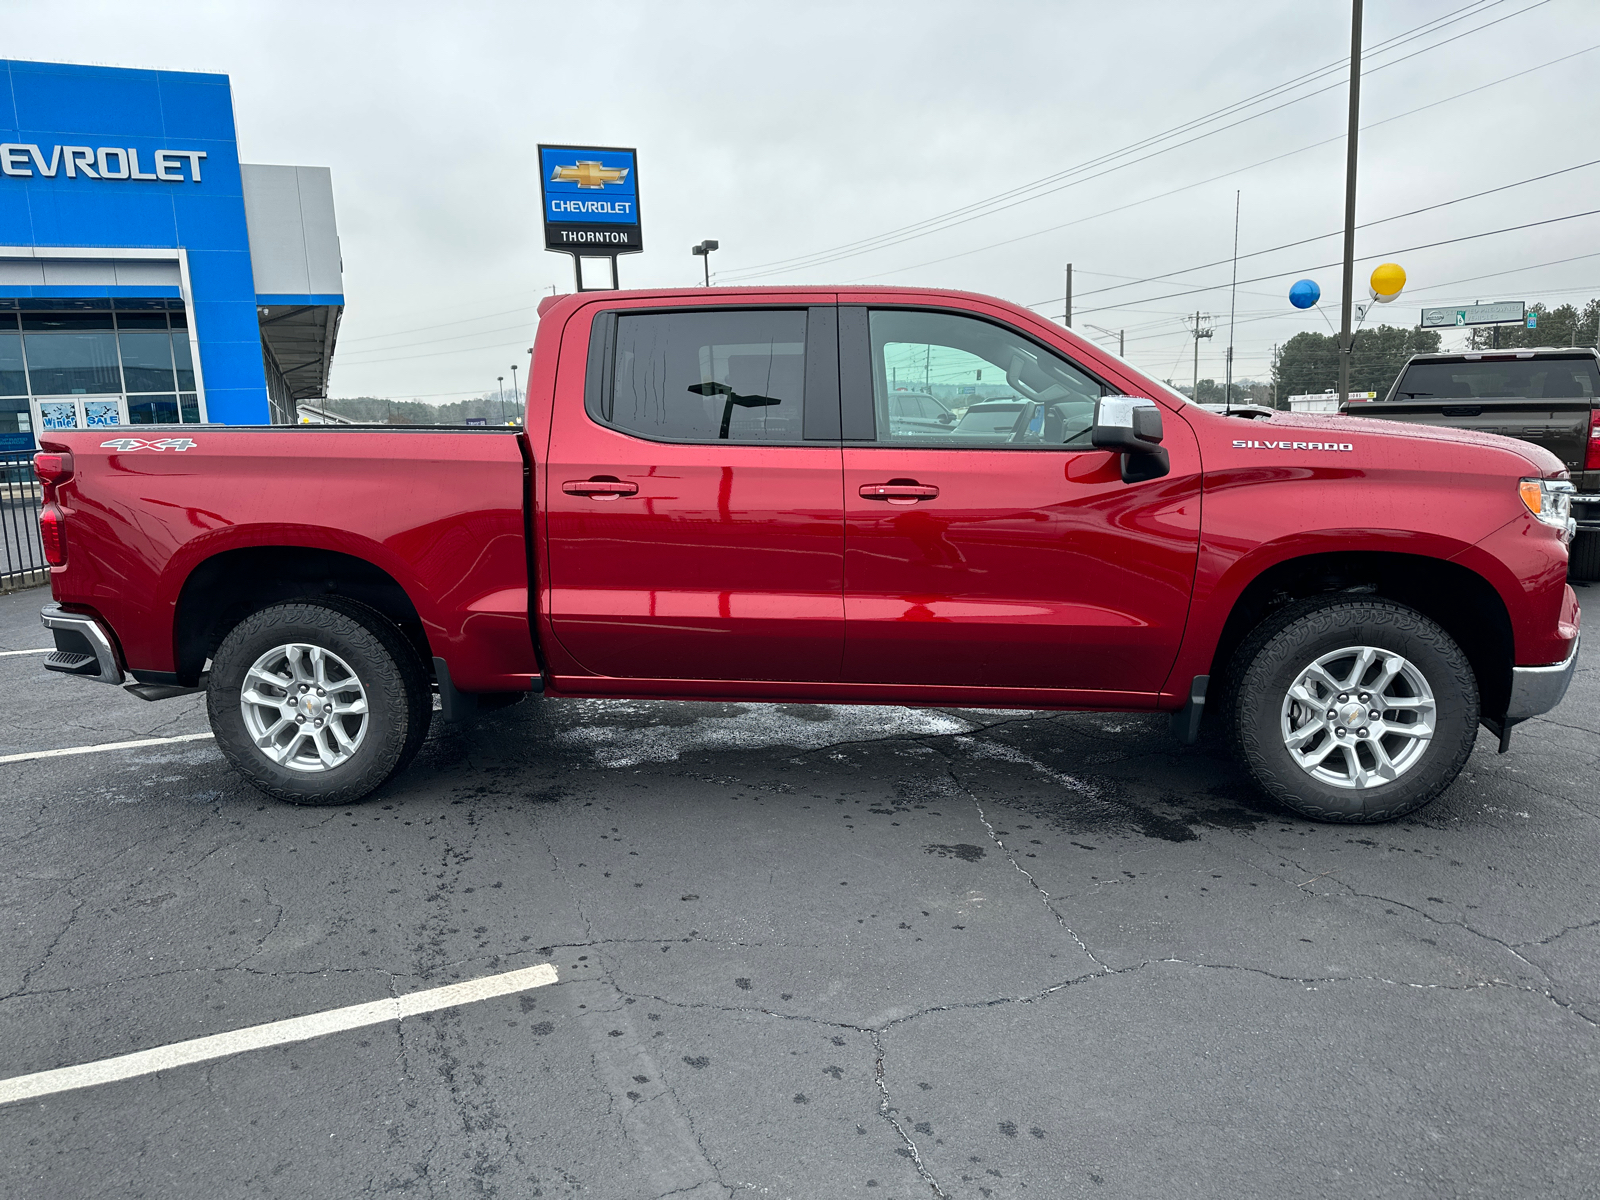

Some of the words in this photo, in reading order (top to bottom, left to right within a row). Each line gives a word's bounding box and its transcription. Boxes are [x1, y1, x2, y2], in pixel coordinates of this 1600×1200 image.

[551, 200, 632, 214] CHEVROLET
[560, 231, 628, 243] THORNTON
[43, 416, 76, 429] Winter
[87, 415, 119, 426] SALE
[1232, 440, 1353, 452] SILVERADO
